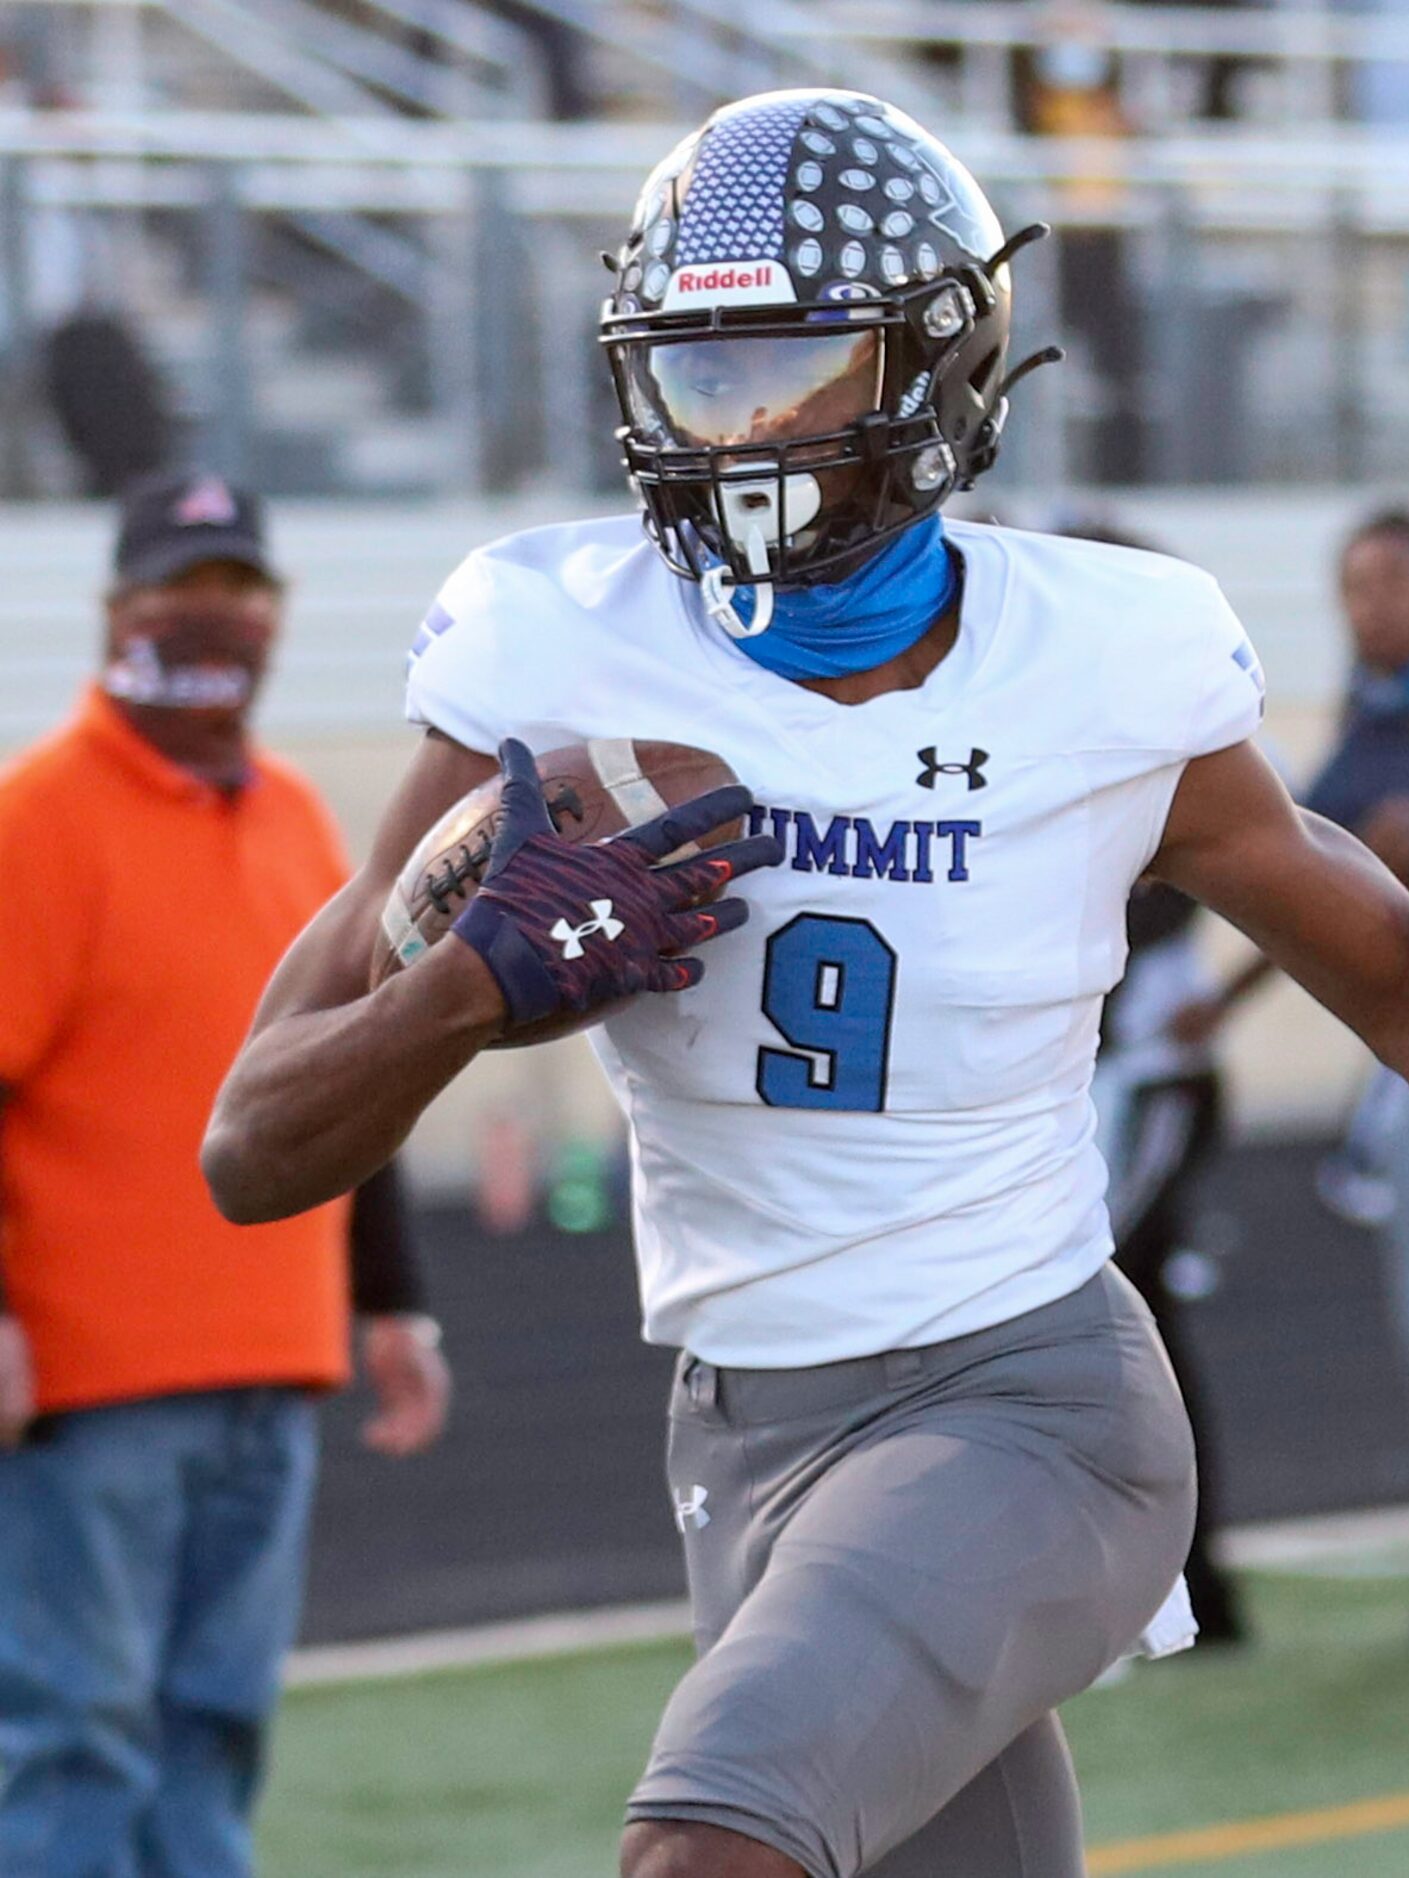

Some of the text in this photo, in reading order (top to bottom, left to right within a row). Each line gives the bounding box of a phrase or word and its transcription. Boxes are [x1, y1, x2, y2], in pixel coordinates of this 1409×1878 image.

[678, 265, 771, 293] Riddell
[749, 806, 981, 883] UMMIT
[755, 911, 897, 1113] 9
